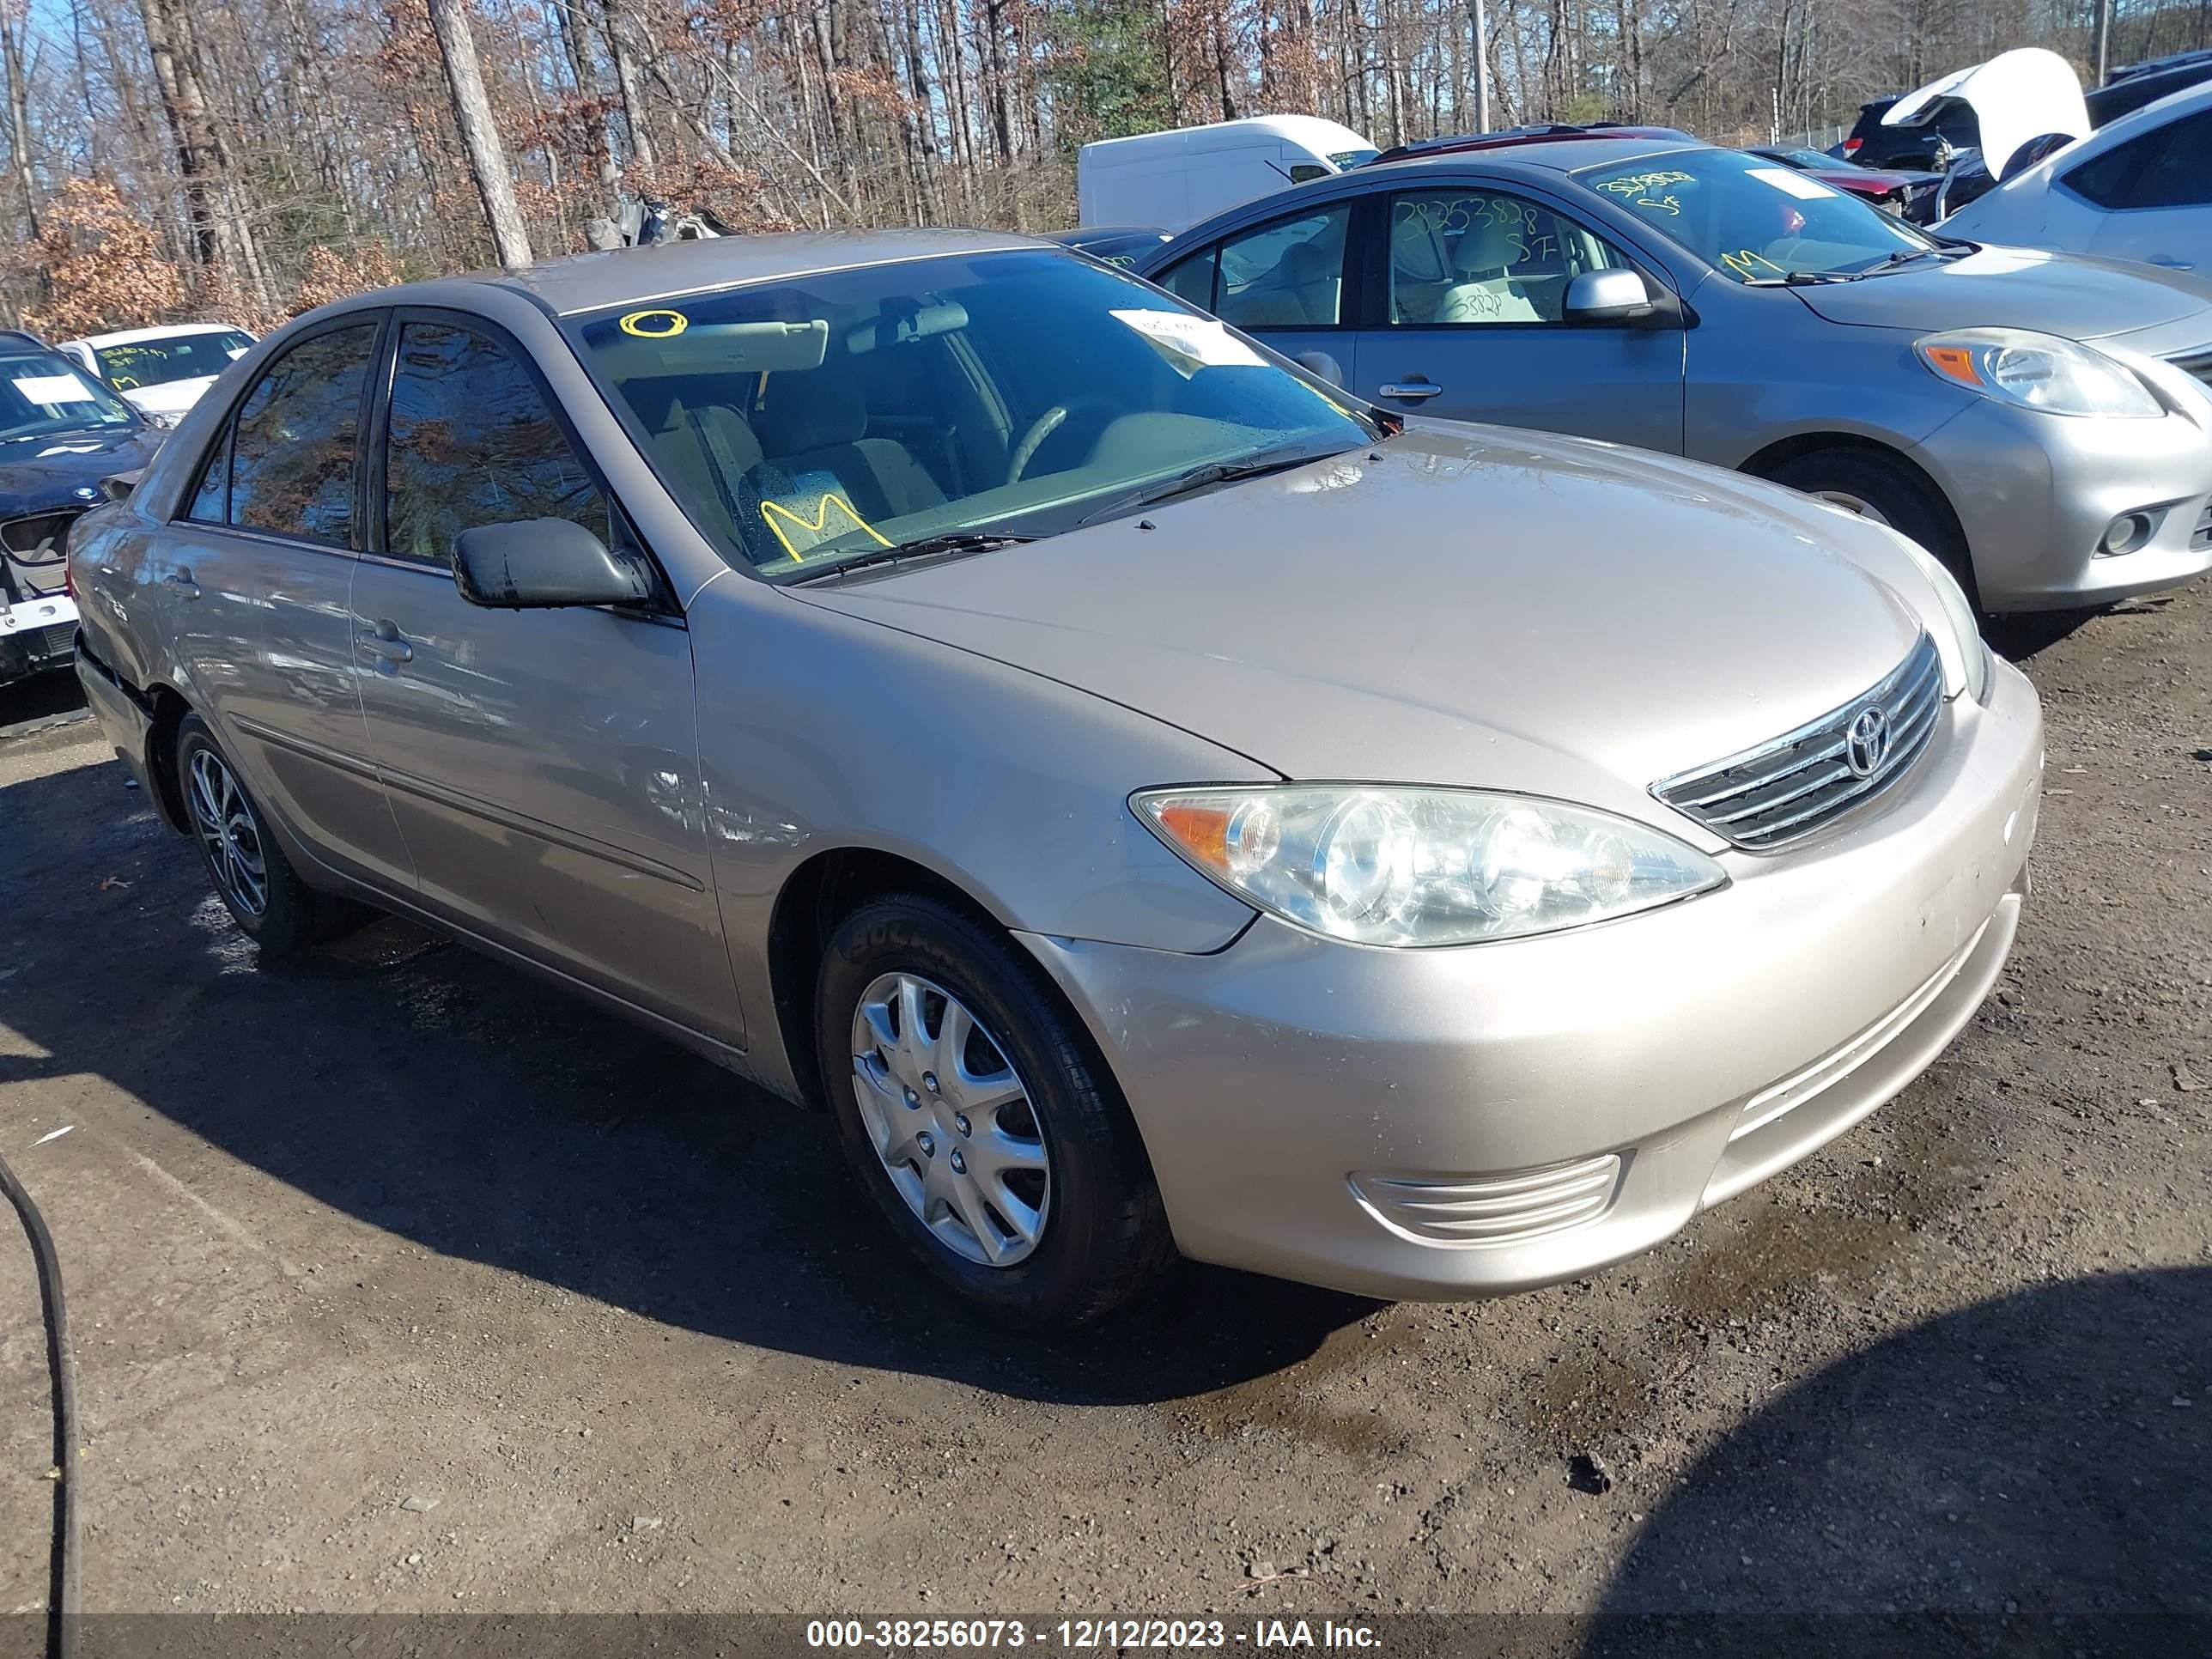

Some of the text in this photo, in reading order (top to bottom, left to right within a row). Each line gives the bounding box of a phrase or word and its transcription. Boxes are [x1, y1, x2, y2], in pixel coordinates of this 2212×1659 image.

[1395, 198, 1538, 241] 38253828
[1721, 249, 1787, 280] M
[111, 375, 140, 391] M
[761, 494, 897, 563] M
